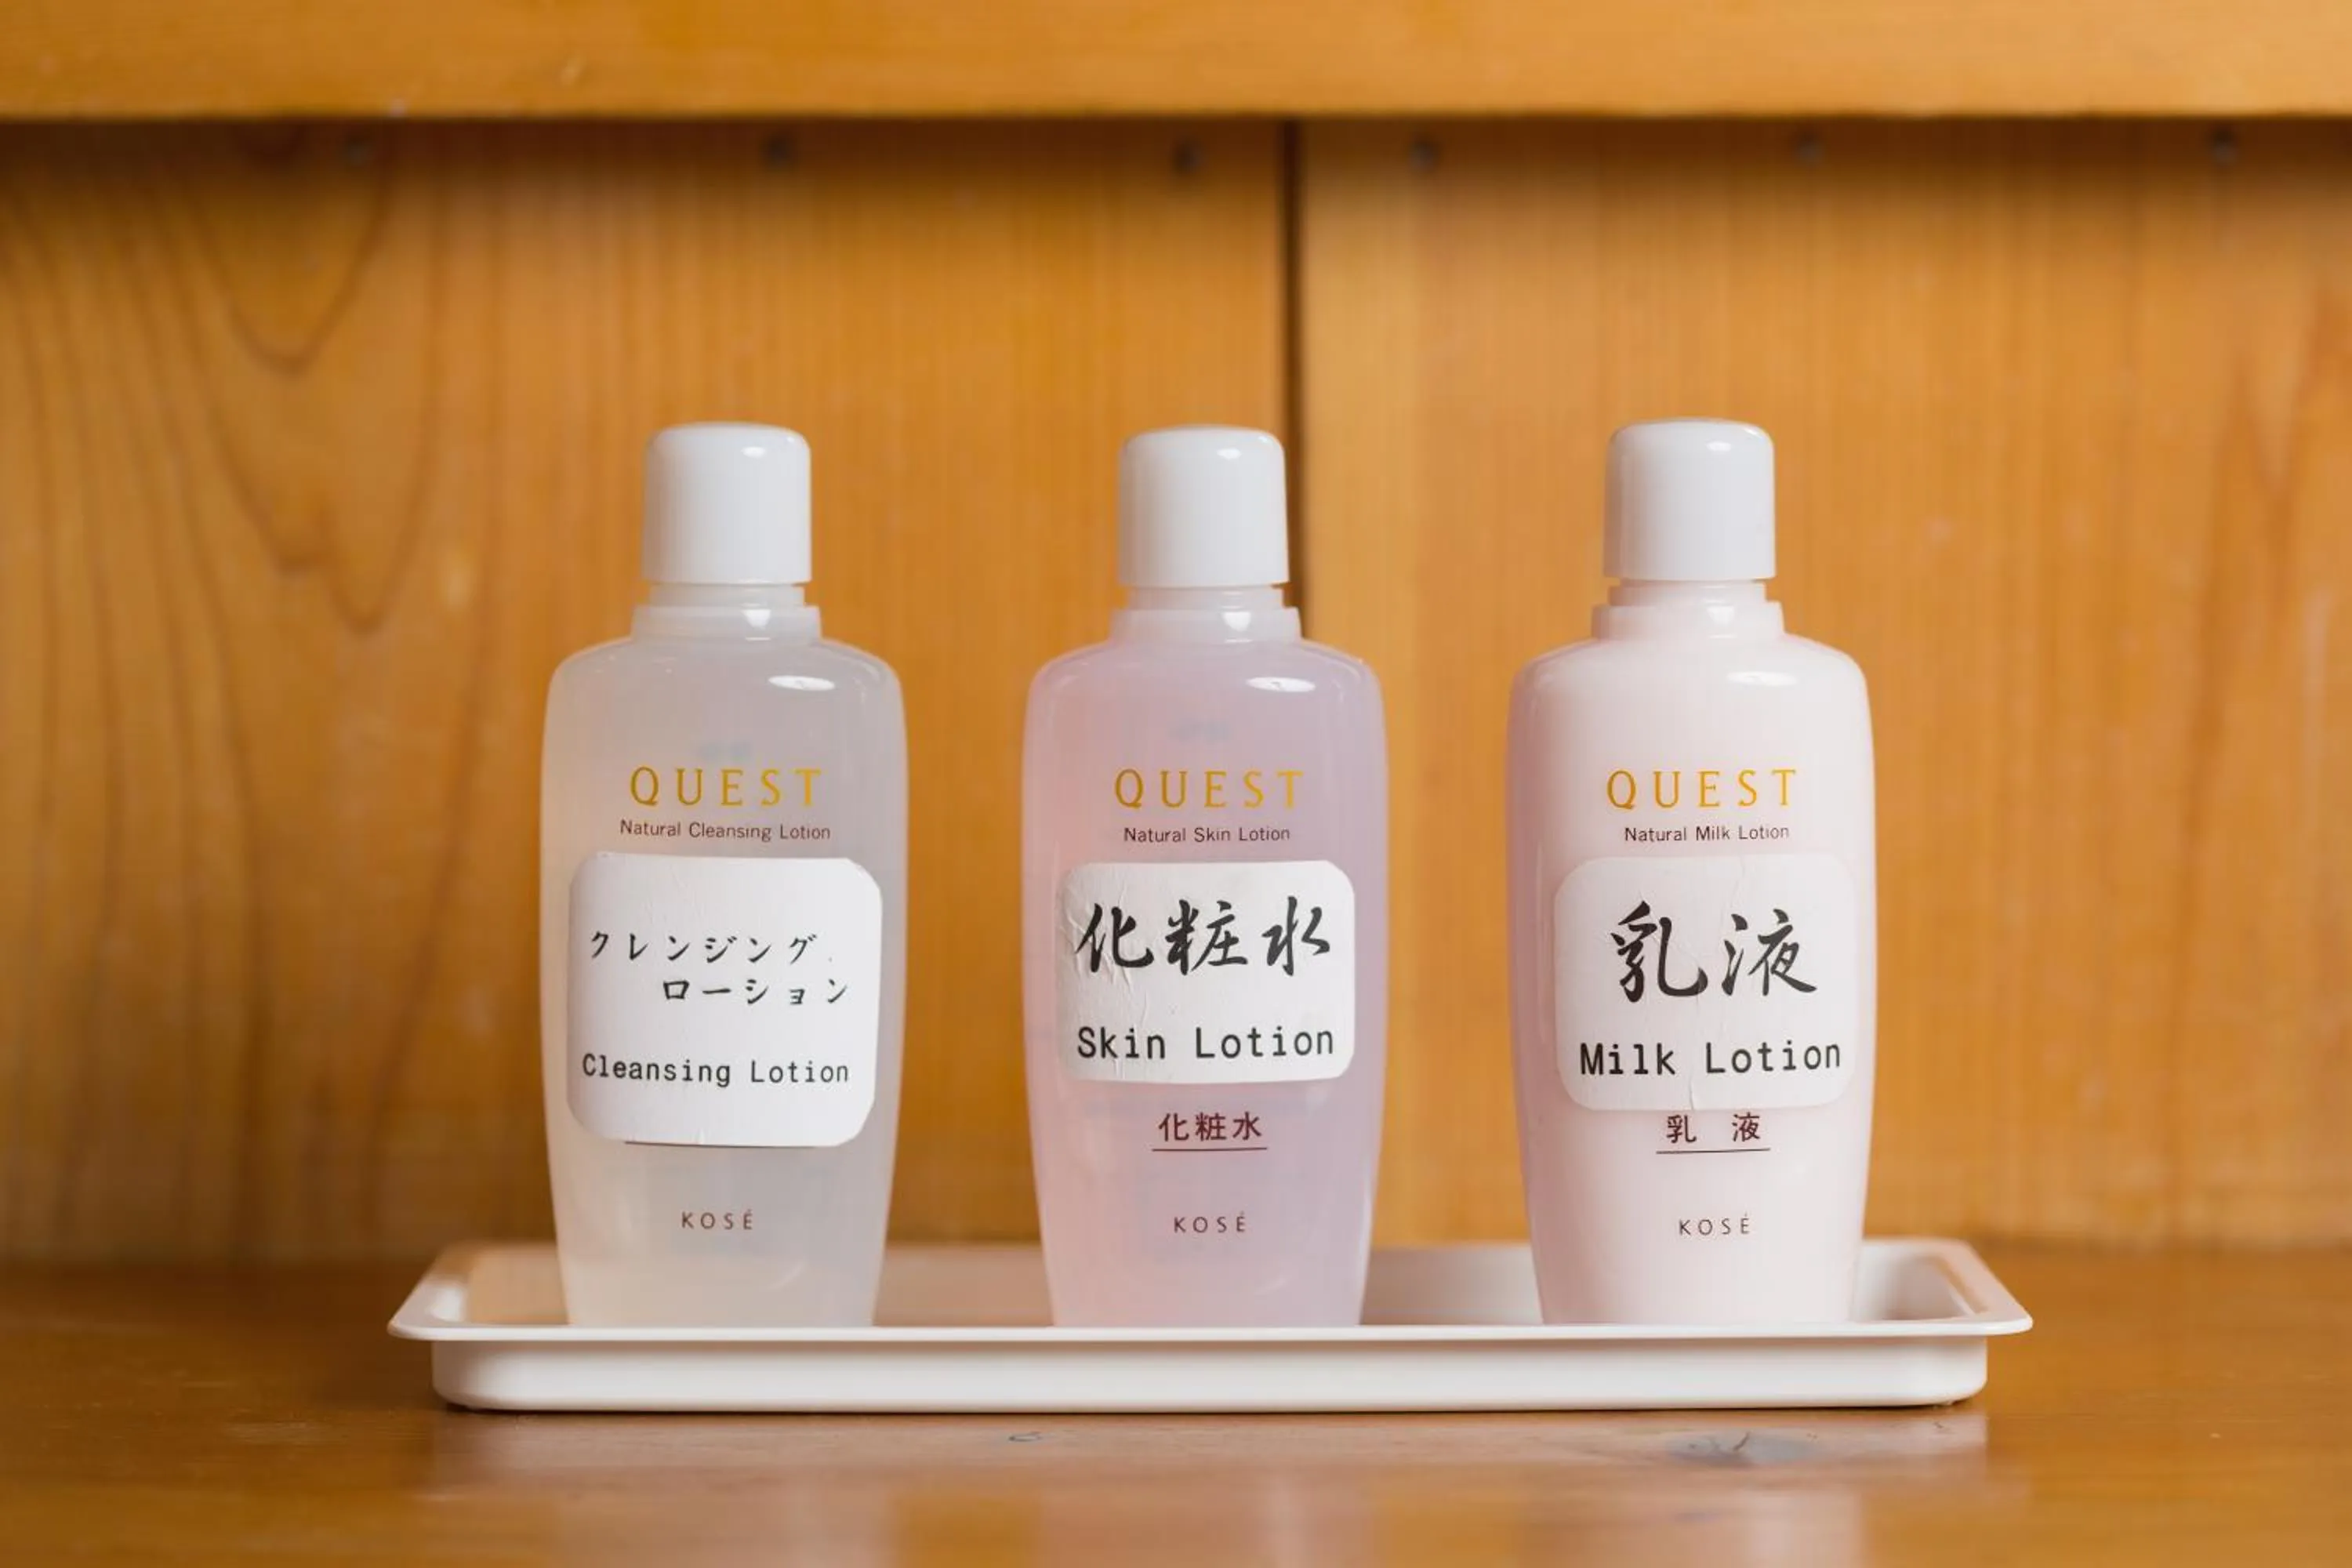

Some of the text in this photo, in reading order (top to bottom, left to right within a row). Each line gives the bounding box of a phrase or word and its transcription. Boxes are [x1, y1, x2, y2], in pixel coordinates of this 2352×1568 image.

[630, 767, 822, 807] QUEST
[1115, 768, 1303, 810] QUEST
[1606, 770, 1796, 811] QUEST
[619, 819, 830, 843] Natural Cleansing Lotion
[1123, 826, 1290, 843] Natural Skin Lotion
[1624, 825, 1789, 842] Natural Milk Lotion
[590, 930, 818, 964] クレンジング
[1076, 895, 1331, 977] 化粧水
[1610, 901, 1817, 1003] 乳液
[663, 978, 848, 1005] ローション
[1077, 1026, 1334, 1059] Skin Lotion
[1581, 1040, 1841, 1076] Milk Lotion
[583, 1054, 849, 1087] Cleansing Lotion
[1158, 1112, 1262, 1142] 化粧水
[681, 1209, 753, 1230] KOSÉ
[1174, 1211, 1246, 1233] KOSÉ
[1679, 1214, 1751, 1236] KOSÉ
